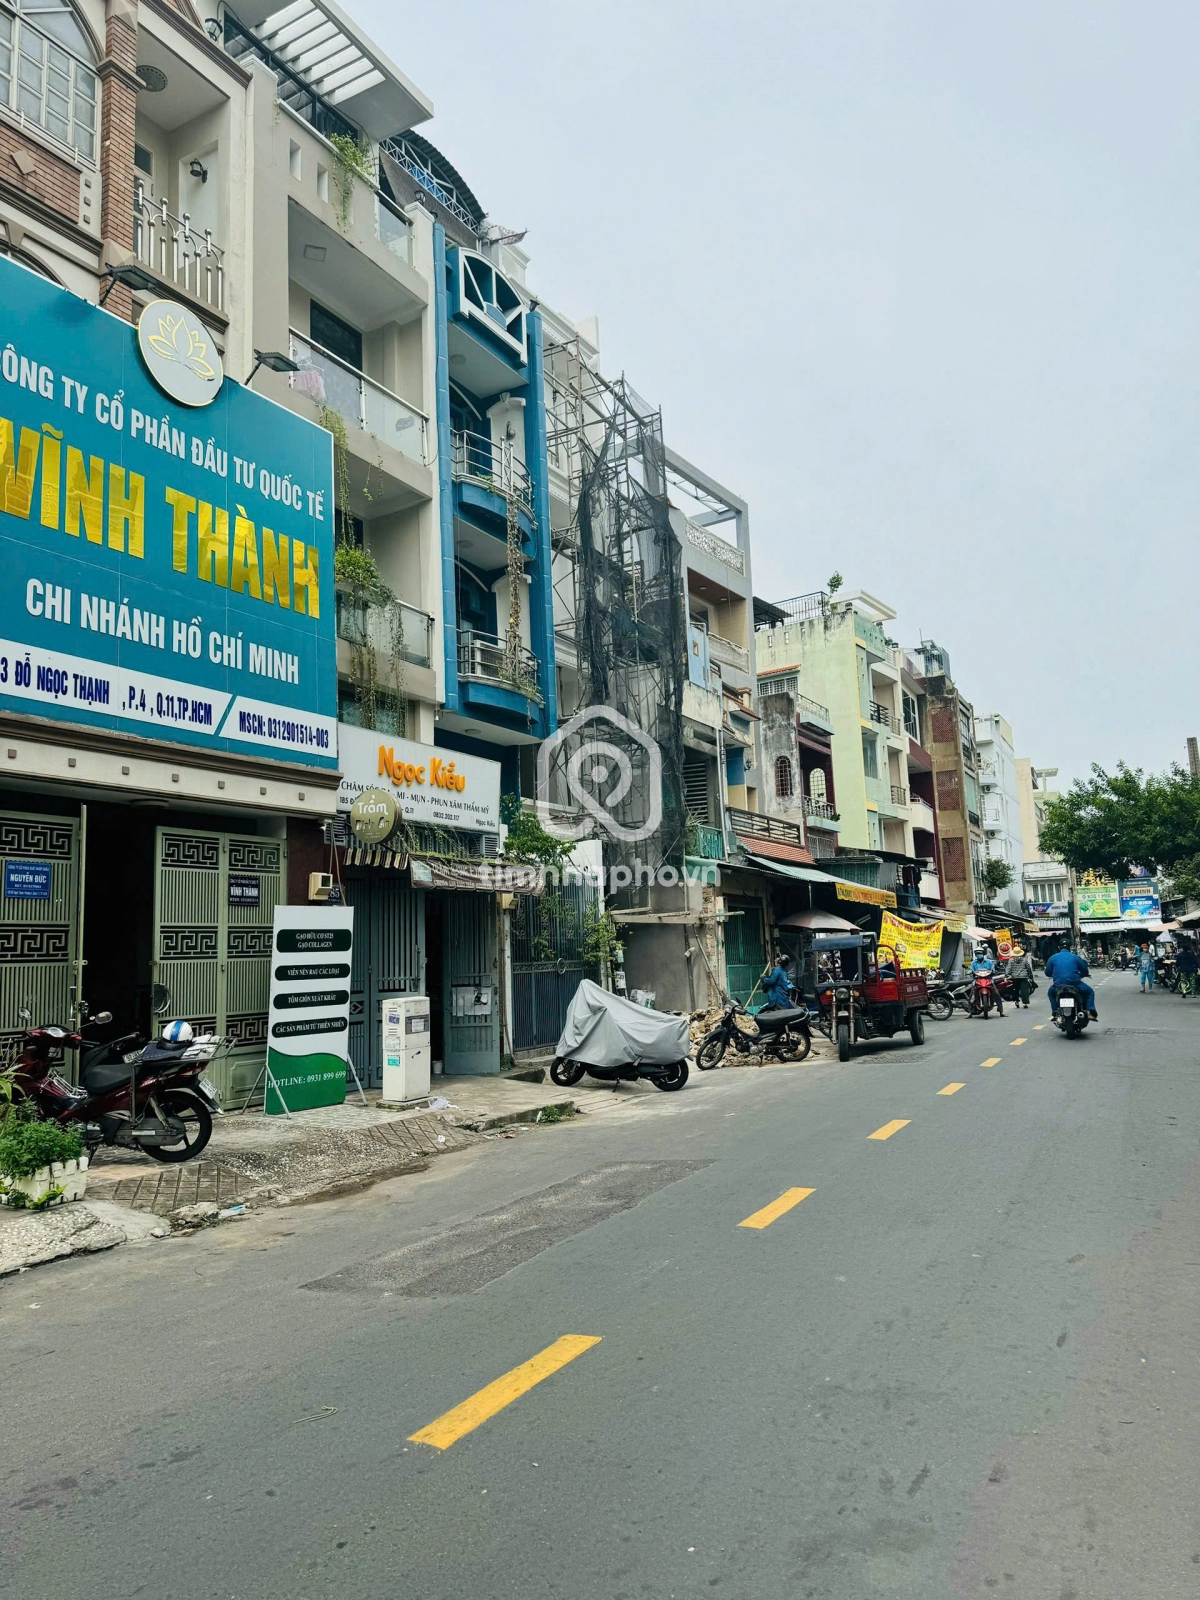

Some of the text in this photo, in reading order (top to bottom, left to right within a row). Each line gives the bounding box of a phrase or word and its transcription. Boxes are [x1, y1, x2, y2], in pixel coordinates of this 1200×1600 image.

[0, 343, 325, 520] ÔNG TY CỔ PHẦN ĐẦU TƯ QUỐC TẾ
[0, 416, 320, 619] VĨNH THÀNH
[26, 578, 300, 685] CHI NHÁNH HỒ CHÍ MINH
[15, 652, 32, 688] ĐỖ
[36, 664, 69, 699] NGỌC
[73, 673, 110, 706] THẠNH
[239, 711, 329, 749] MSCN: 0312901514-003
[378, 744, 466, 792] Ngọc Kiều
[341, 780, 364, 793] CHĂM
[430, 796, 448, 808] PHUN
[306, 1073, 322, 1083] 0931
[323, 1072, 335, 1081] 899
[335, 1070, 347, 1079] 699
